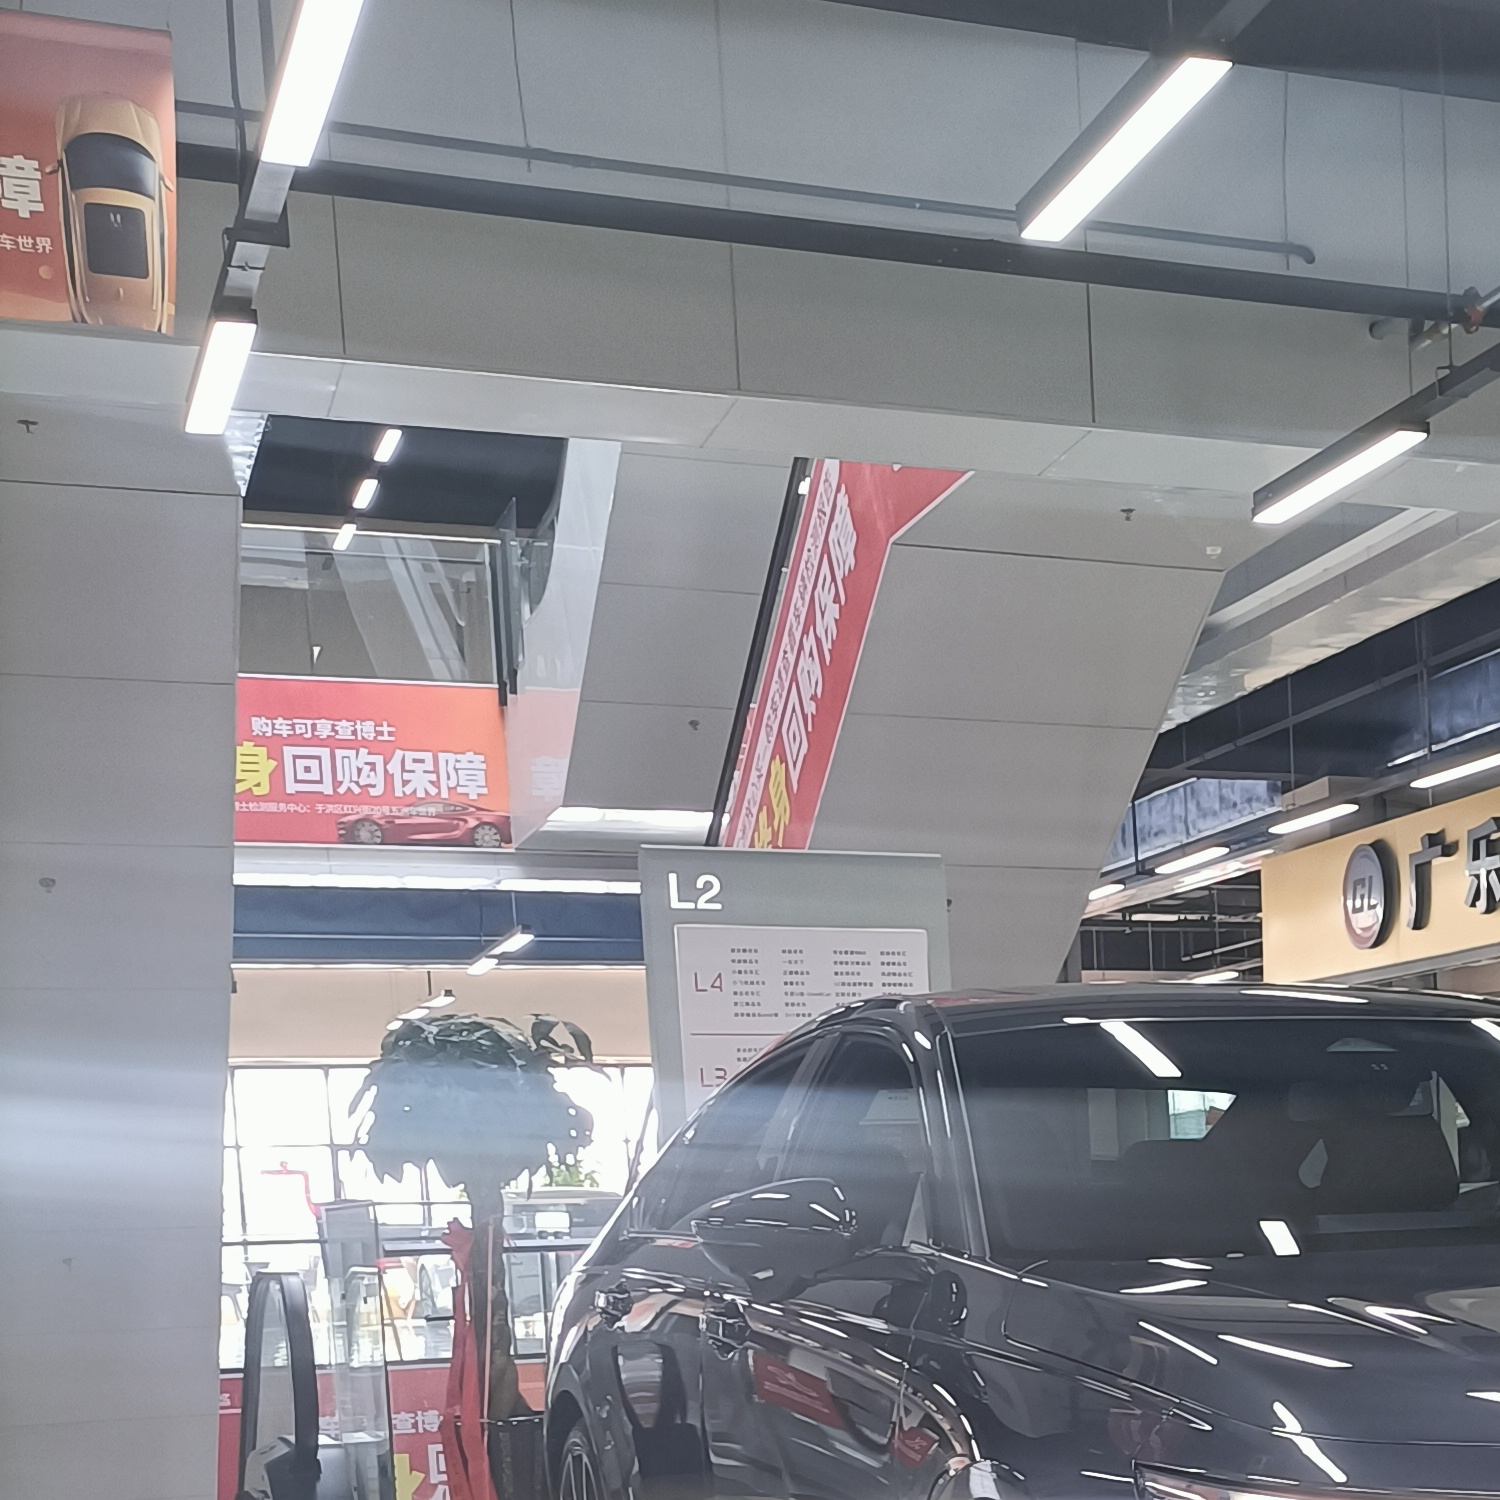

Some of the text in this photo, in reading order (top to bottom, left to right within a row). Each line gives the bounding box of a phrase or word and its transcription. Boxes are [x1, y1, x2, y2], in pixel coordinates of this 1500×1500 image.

[251, 716, 397, 742] 购车可享查博士
[235, 740, 489, 800] 身回购保障
[667, 872, 723, 910] L2
[1351, 875, 1379, 915] GL
[693, 971, 724, 993] L4
[699, 1067, 728, 1088] L3
[392, 1410, 444, 1435] 查博
